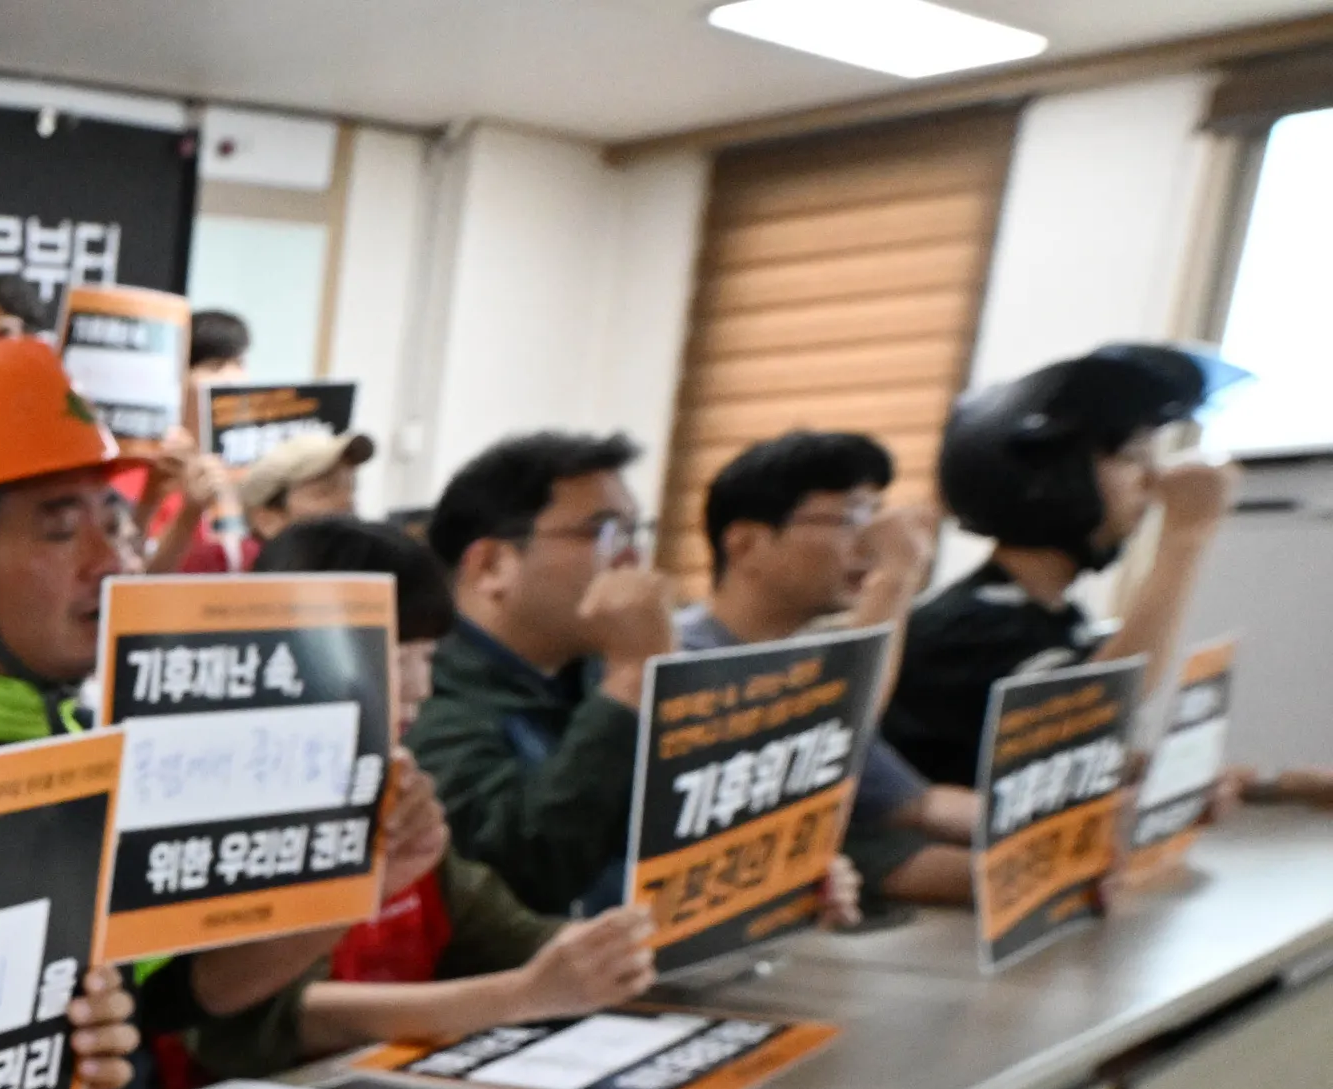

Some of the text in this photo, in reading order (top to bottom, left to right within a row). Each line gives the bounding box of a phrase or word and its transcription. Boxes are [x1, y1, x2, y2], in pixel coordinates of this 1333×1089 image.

[126, 643, 261, 704] 기후재난
[672, 717, 854, 839] 기후위기는
[146, 816, 370, 895] 위한 우리의 권리
